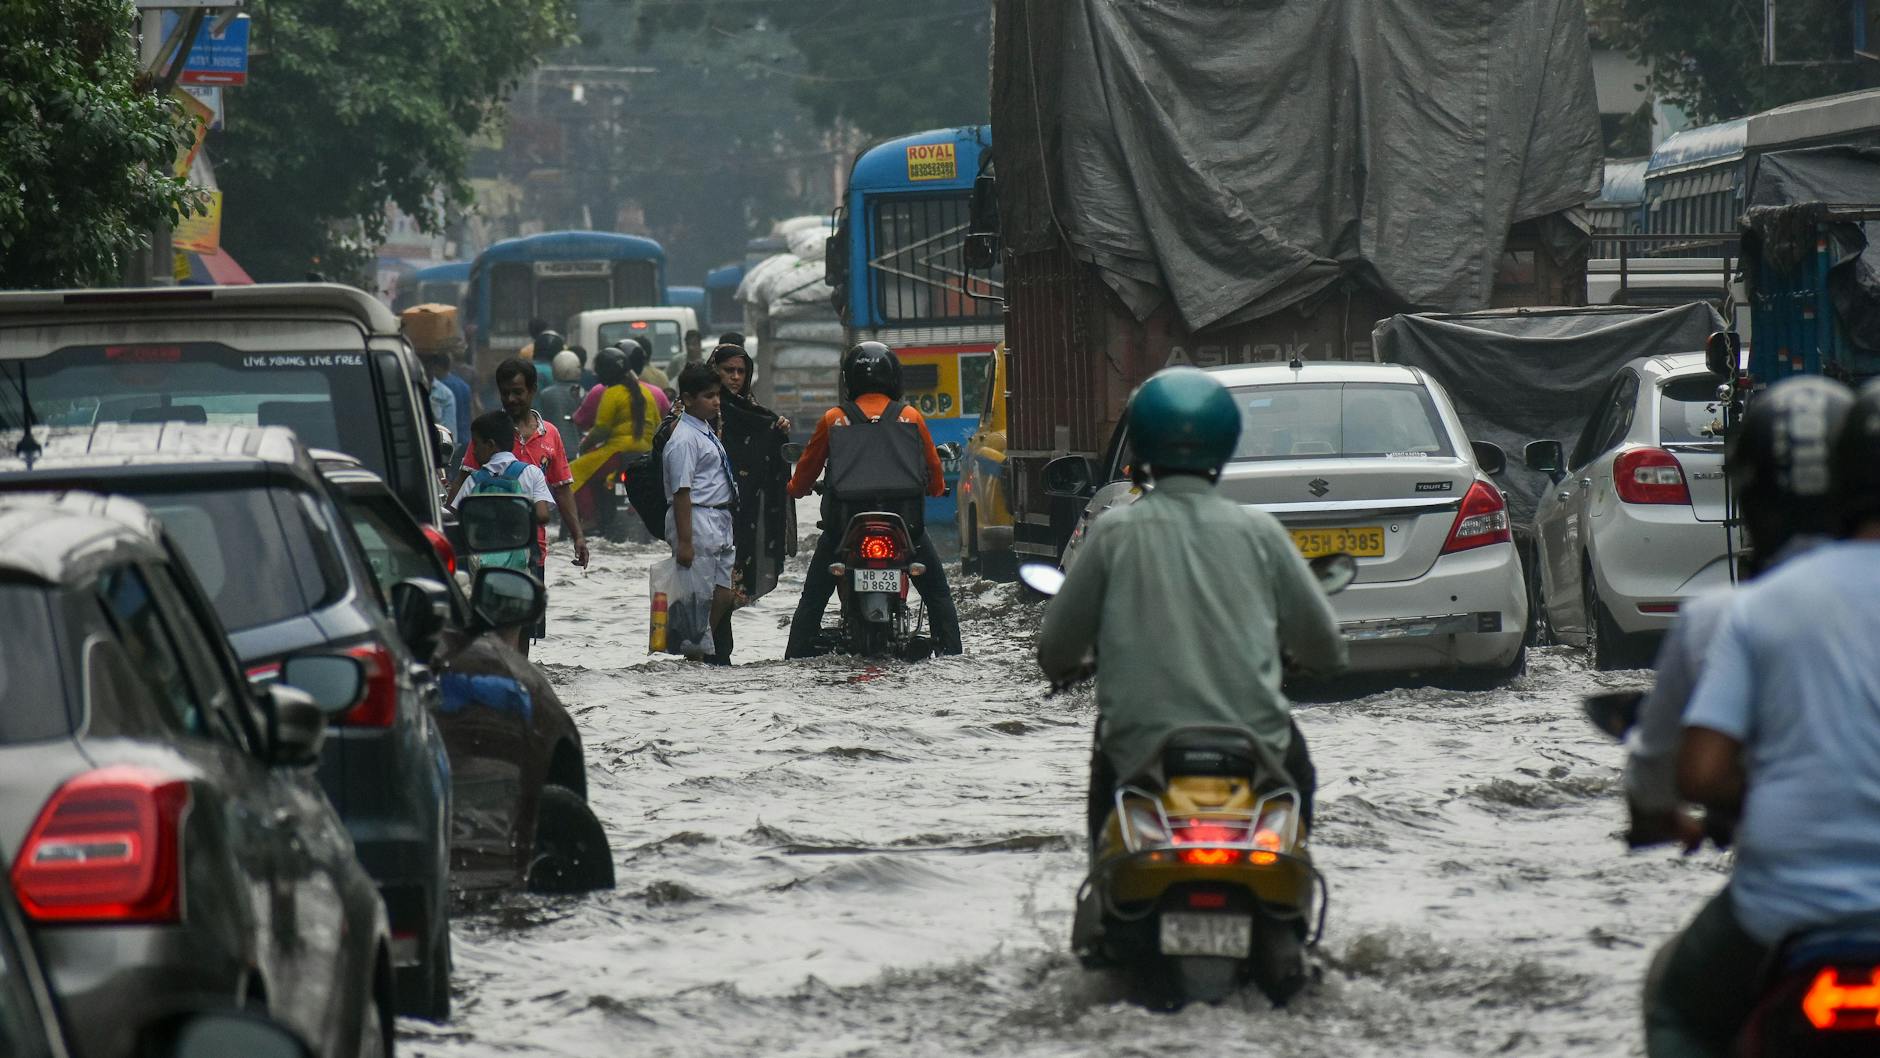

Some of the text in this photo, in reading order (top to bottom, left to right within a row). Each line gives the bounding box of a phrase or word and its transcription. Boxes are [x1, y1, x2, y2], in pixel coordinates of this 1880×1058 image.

[909, 145, 952, 160] ROYAL
[243, 355, 363, 367] LIVE YOUNG LIVE FREE
[900, 392, 953, 416] TOP
[1337, 533, 1380, 551] 3385
[863, 571, 895, 580] WB 28
[863, 581, 898, 590] D 8628
